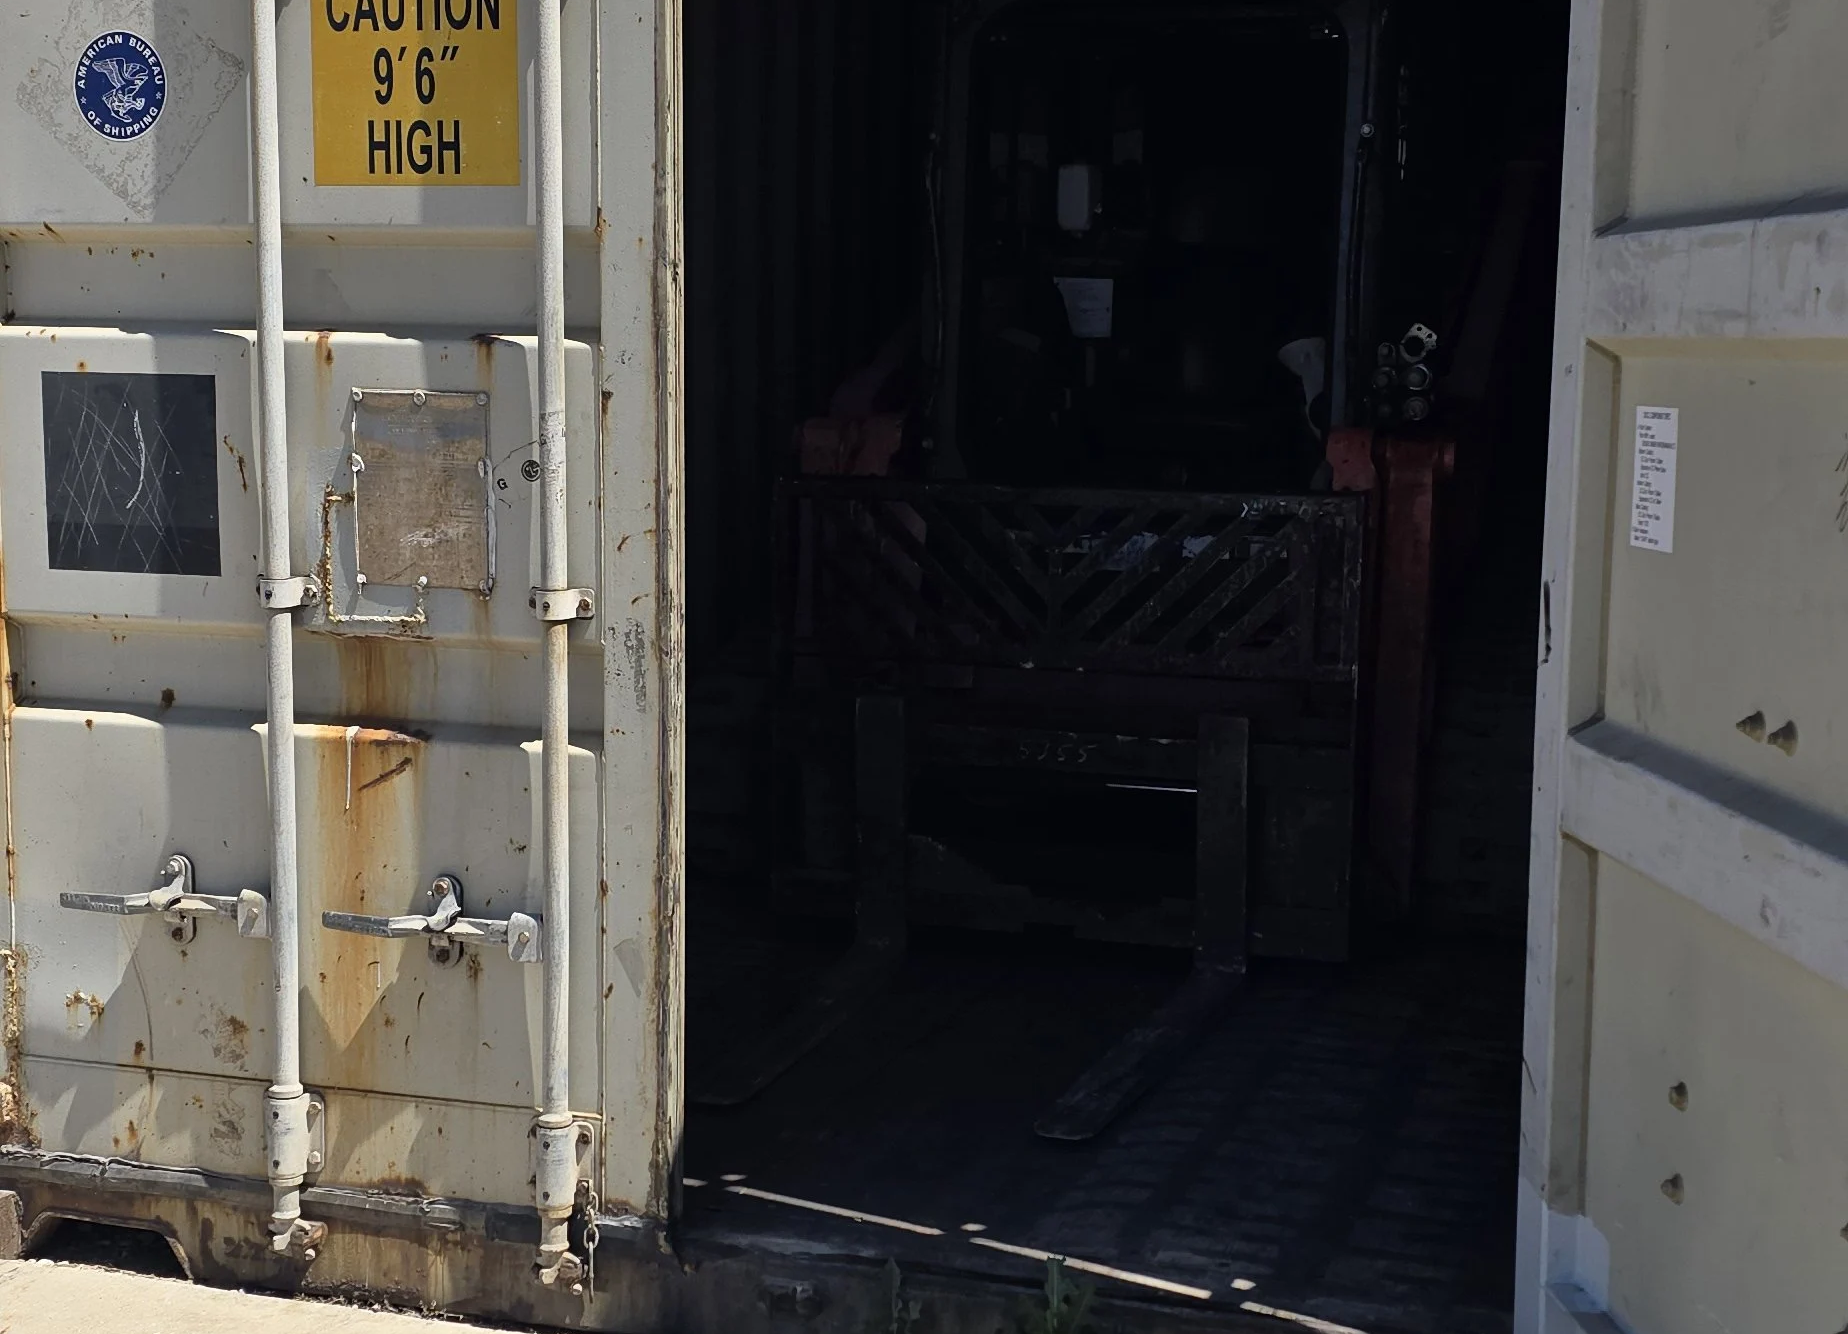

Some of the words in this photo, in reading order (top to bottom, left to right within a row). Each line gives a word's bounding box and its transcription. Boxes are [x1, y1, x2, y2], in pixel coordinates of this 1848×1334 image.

[77, 34, 123, 89] AMERICAN
[128, 36, 164, 85] BUREAU
[87, 110, 103, 127] OF
[103, 106, 159, 137] SHIPPING
[367, 119, 462, 175] HIGH
